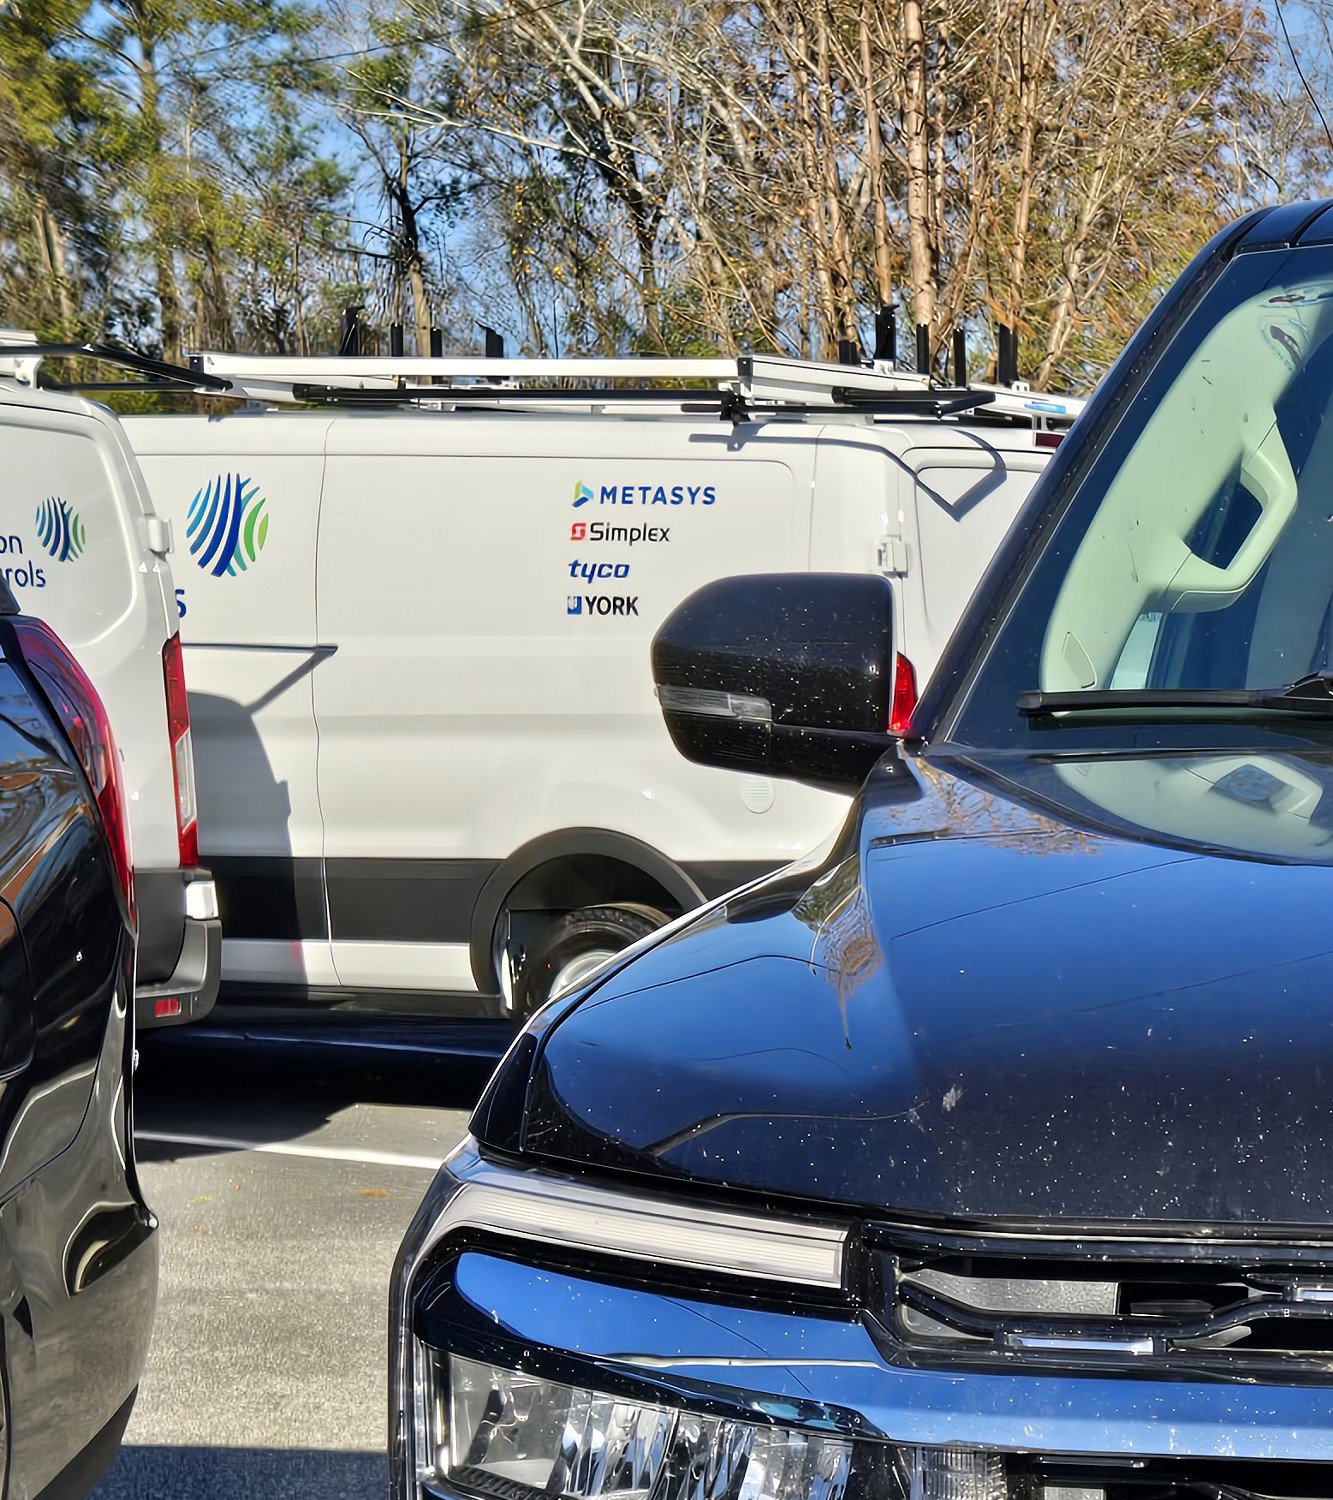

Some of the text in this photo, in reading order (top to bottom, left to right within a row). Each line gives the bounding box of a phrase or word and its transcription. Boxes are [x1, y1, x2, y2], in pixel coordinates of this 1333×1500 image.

[599, 485, 717, 506] METASYS
[589, 522, 670, 546] Simplex
[568, 559, 631, 584] tyco
[585, 595, 640, 616] YORK
